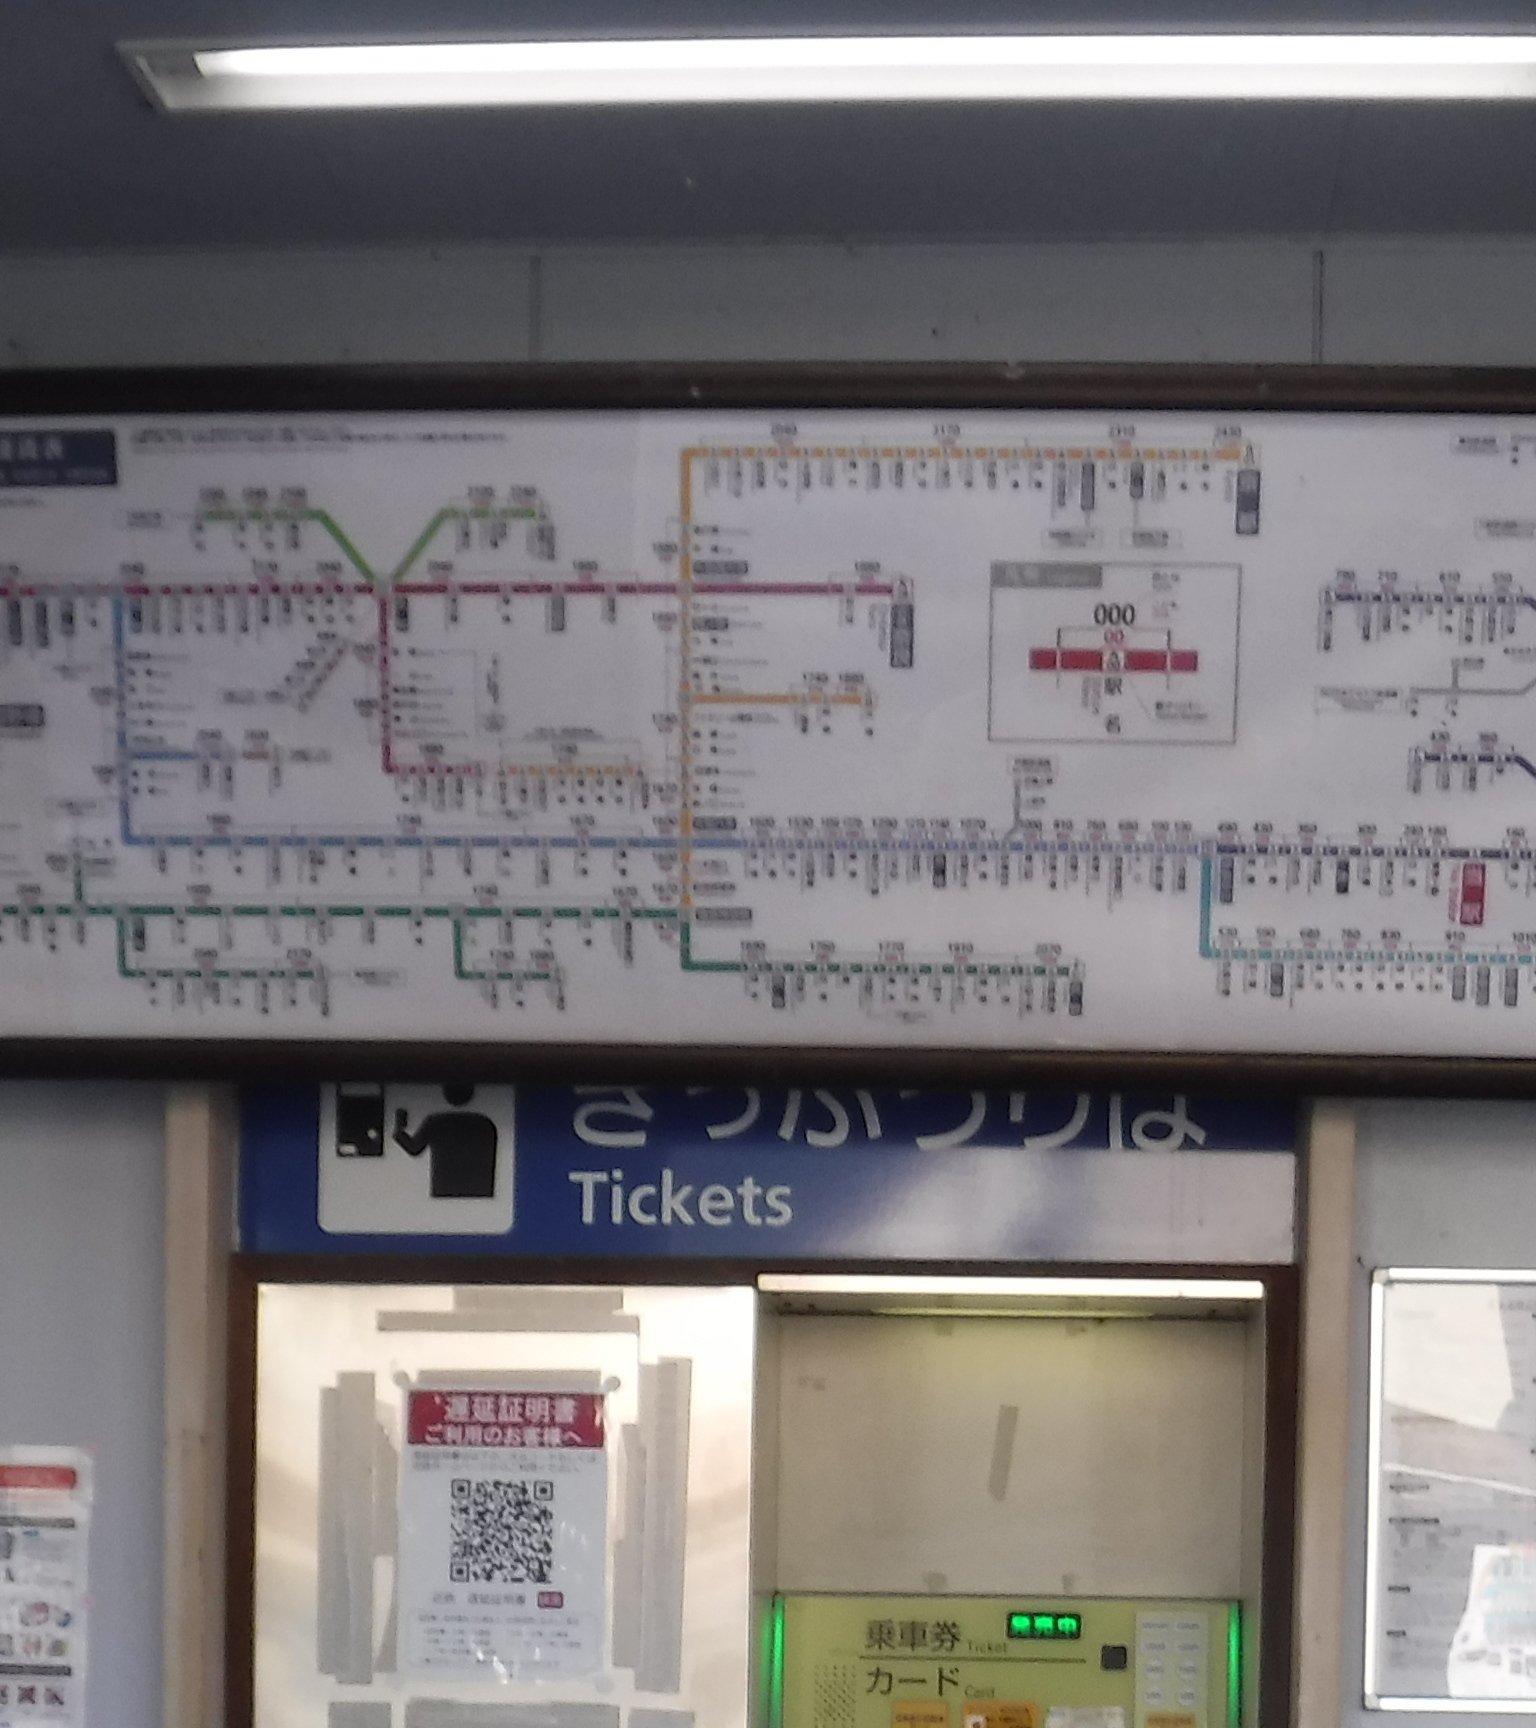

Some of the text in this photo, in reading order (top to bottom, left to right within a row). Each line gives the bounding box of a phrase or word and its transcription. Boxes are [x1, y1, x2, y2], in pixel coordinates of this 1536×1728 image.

[1094, 603, 1135, 625] 000
[568, 1168, 794, 1226] Tickets
[444, 1394, 576, 1423] 遅延証明書
[424, 1423, 583, 1445] ご利用のお客様へ
[865, 1619, 961, 1651] 乗車券
[866, 1667, 960, 1697] カード
